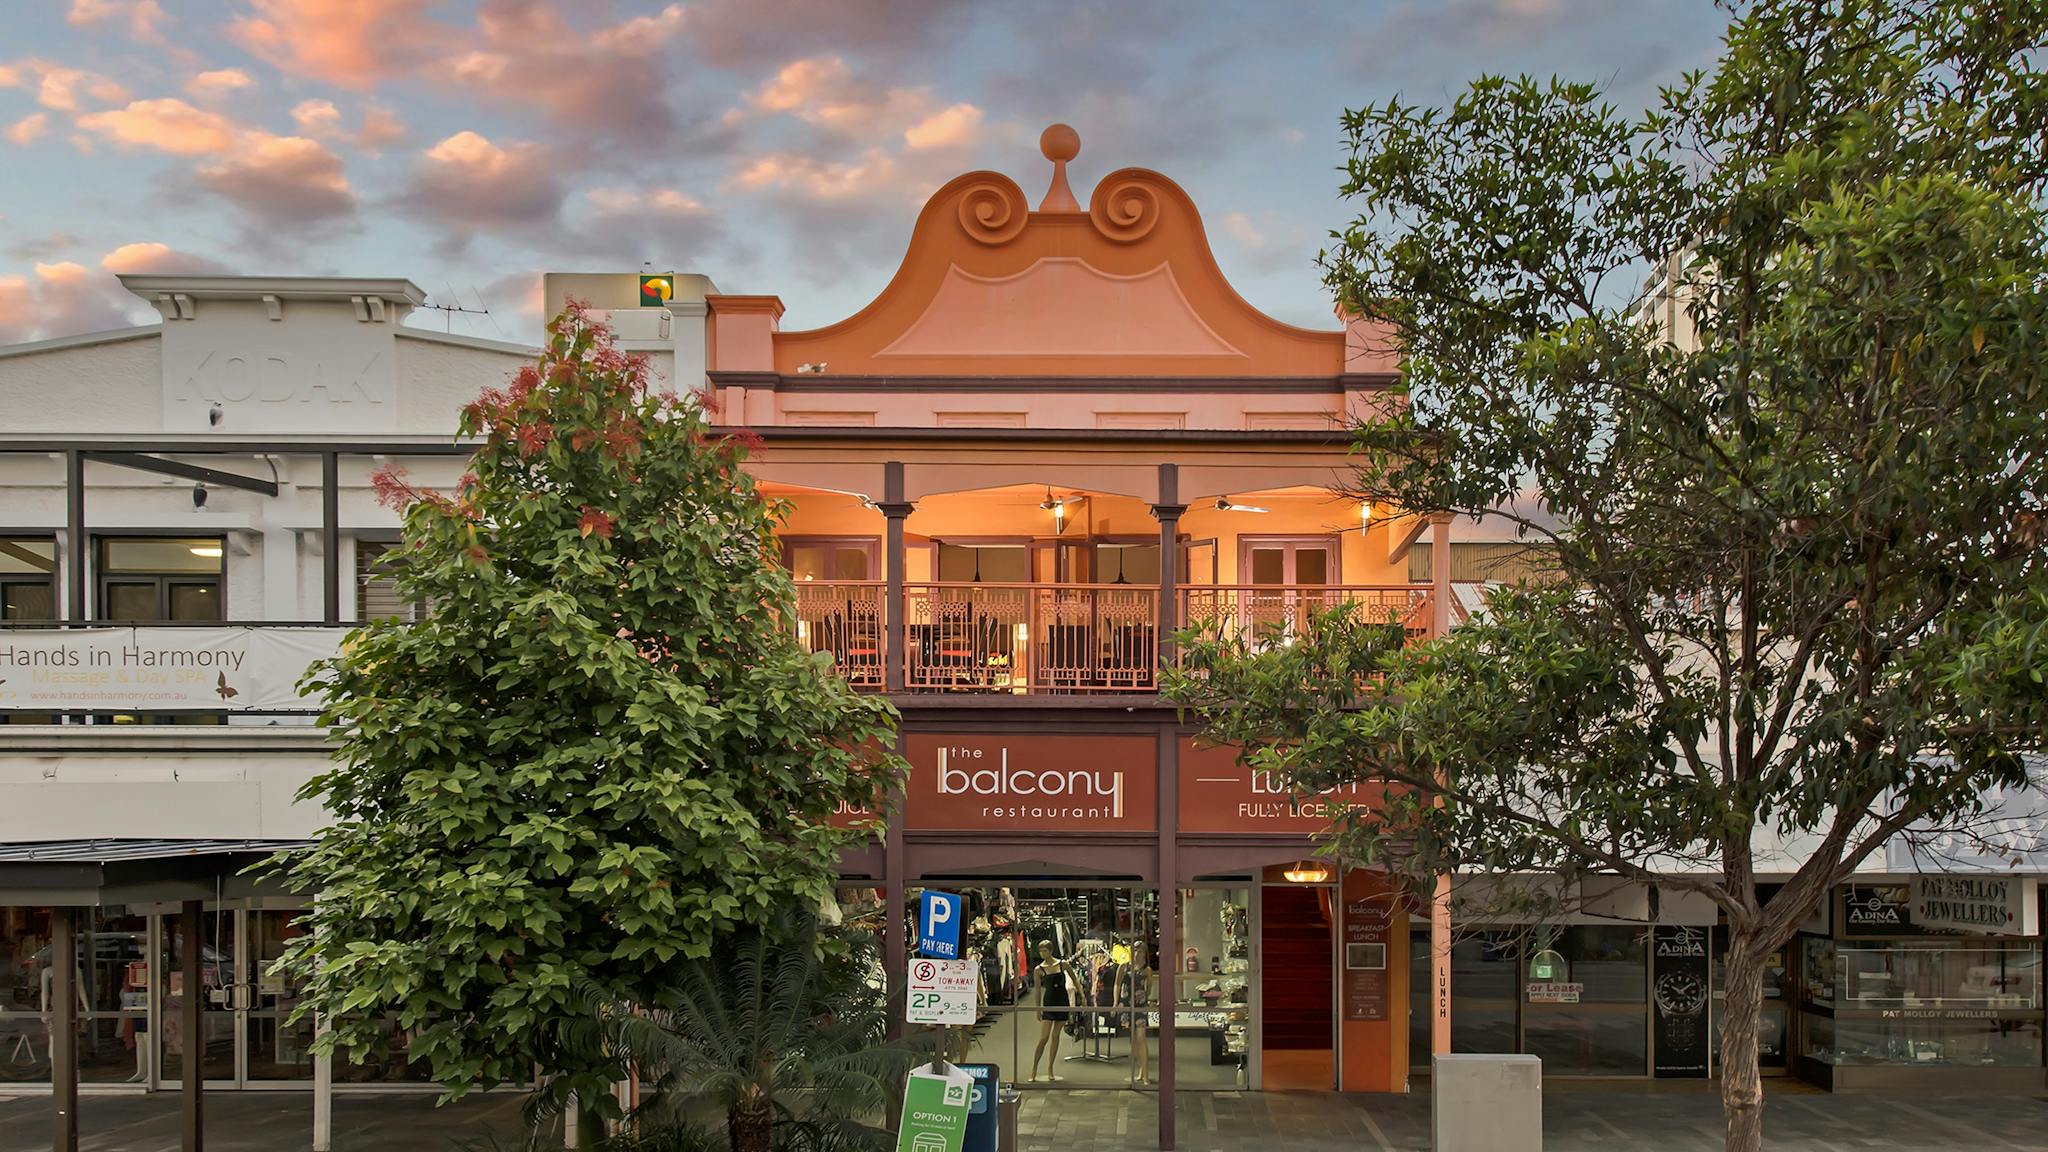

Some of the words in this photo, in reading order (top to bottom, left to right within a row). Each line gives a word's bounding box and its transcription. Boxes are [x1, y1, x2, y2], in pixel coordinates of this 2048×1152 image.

[176, 351, 383, 403] KODAK
[0, 645, 80, 667] Hands
[90, 645, 111, 666] in
[123, 646, 245, 671] Harmony
[32, 669, 109, 686] Massage
[116, 669, 129, 683] &
[137, 669, 169, 686] Day
[175, 669, 207, 683] SPA
[951, 747, 983, 758] the
[937, 747, 1124, 818] balcony
[983, 805, 1110, 818] restaurant
[1238, 803, 1283, 818] FULLY
[928, 895, 951, 937] P
[1924, 900, 2008, 924] JEWELLERS
[922, 939, 936, 951] PAY
[936, 941, 954, 955] HERE
[938, 977, 975, 986] TOW-AWAY
[1439, 966, 1447, 1018] LUNCH
[912, 993, 941, 1008] 2P
[1882, 1010, 1900, 1018] PAT
[1903, 1010, 1942, 1018] MOLLOY
[1945, 1010, 1998, 1018] JEWELLERS
[912, 1111, 951, 1123] OPTION
